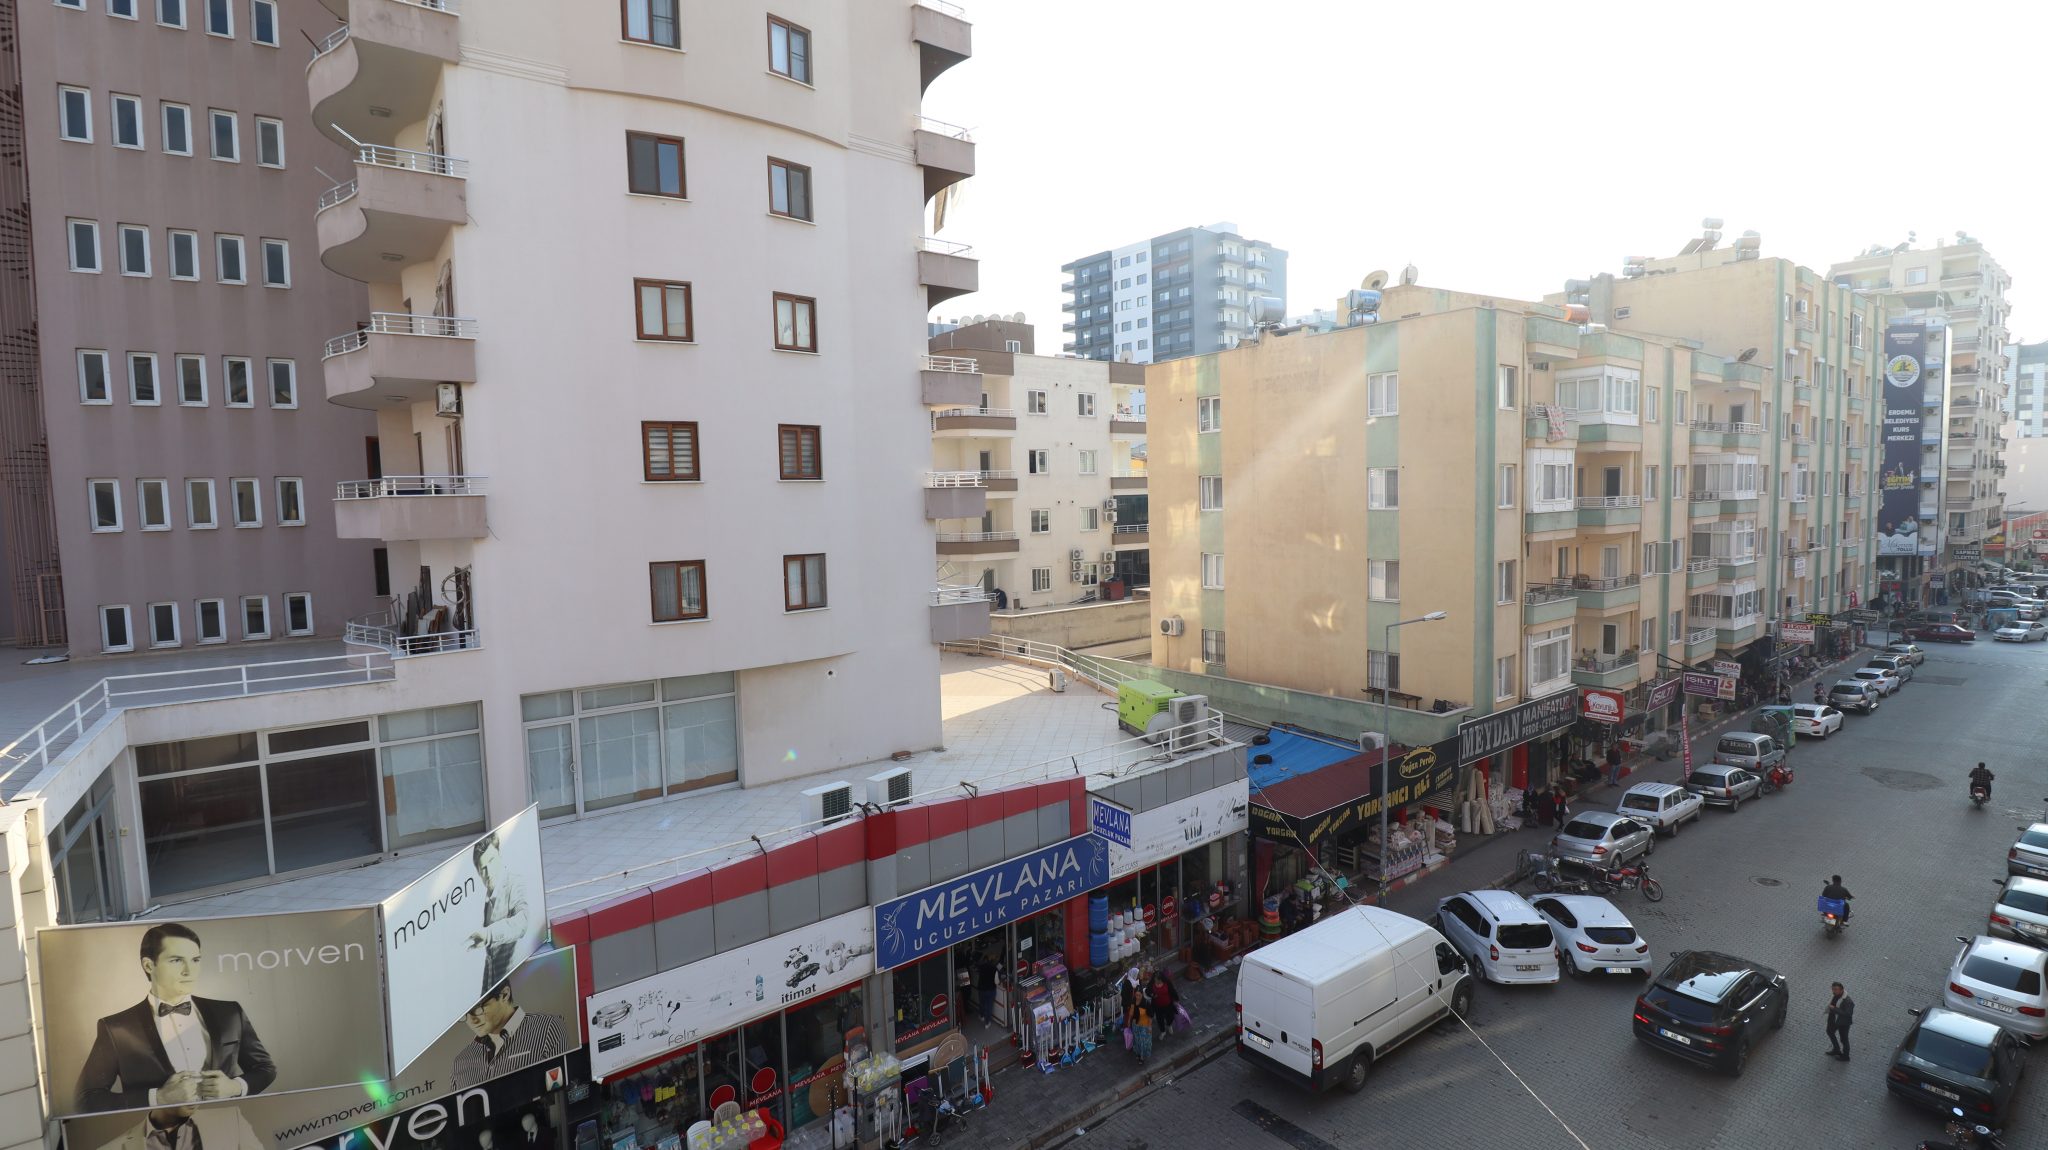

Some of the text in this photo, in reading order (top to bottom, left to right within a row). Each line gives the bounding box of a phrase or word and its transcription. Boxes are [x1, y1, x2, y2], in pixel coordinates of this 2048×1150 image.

[1714, 662, 1740, 671] ESMA
[1461, 711, 1521, 760] MEYDAN
[1521, 722, 1539, 737] PERDE
[1093, 802, 1130, 835] MEVLANA
[1328, 807, 1350, 834] YORGAN
[915, 846, 1081, 930] MEVLANA
[394, 876, 475, 949] morven
[914, 875, 1084, 951] UCUZLUK PAZARI
[218, 942, 364, 973] morven
[781, 983, 817, 1004] itimat
[921, 1017, 949, 1033] MEVLANA
[794, 1071, 826, 1089] MEVLANA
[275, 1077, 437, 1141] www.morven.com.tr
[749, 1088, 783, 1107] MEVLANA
